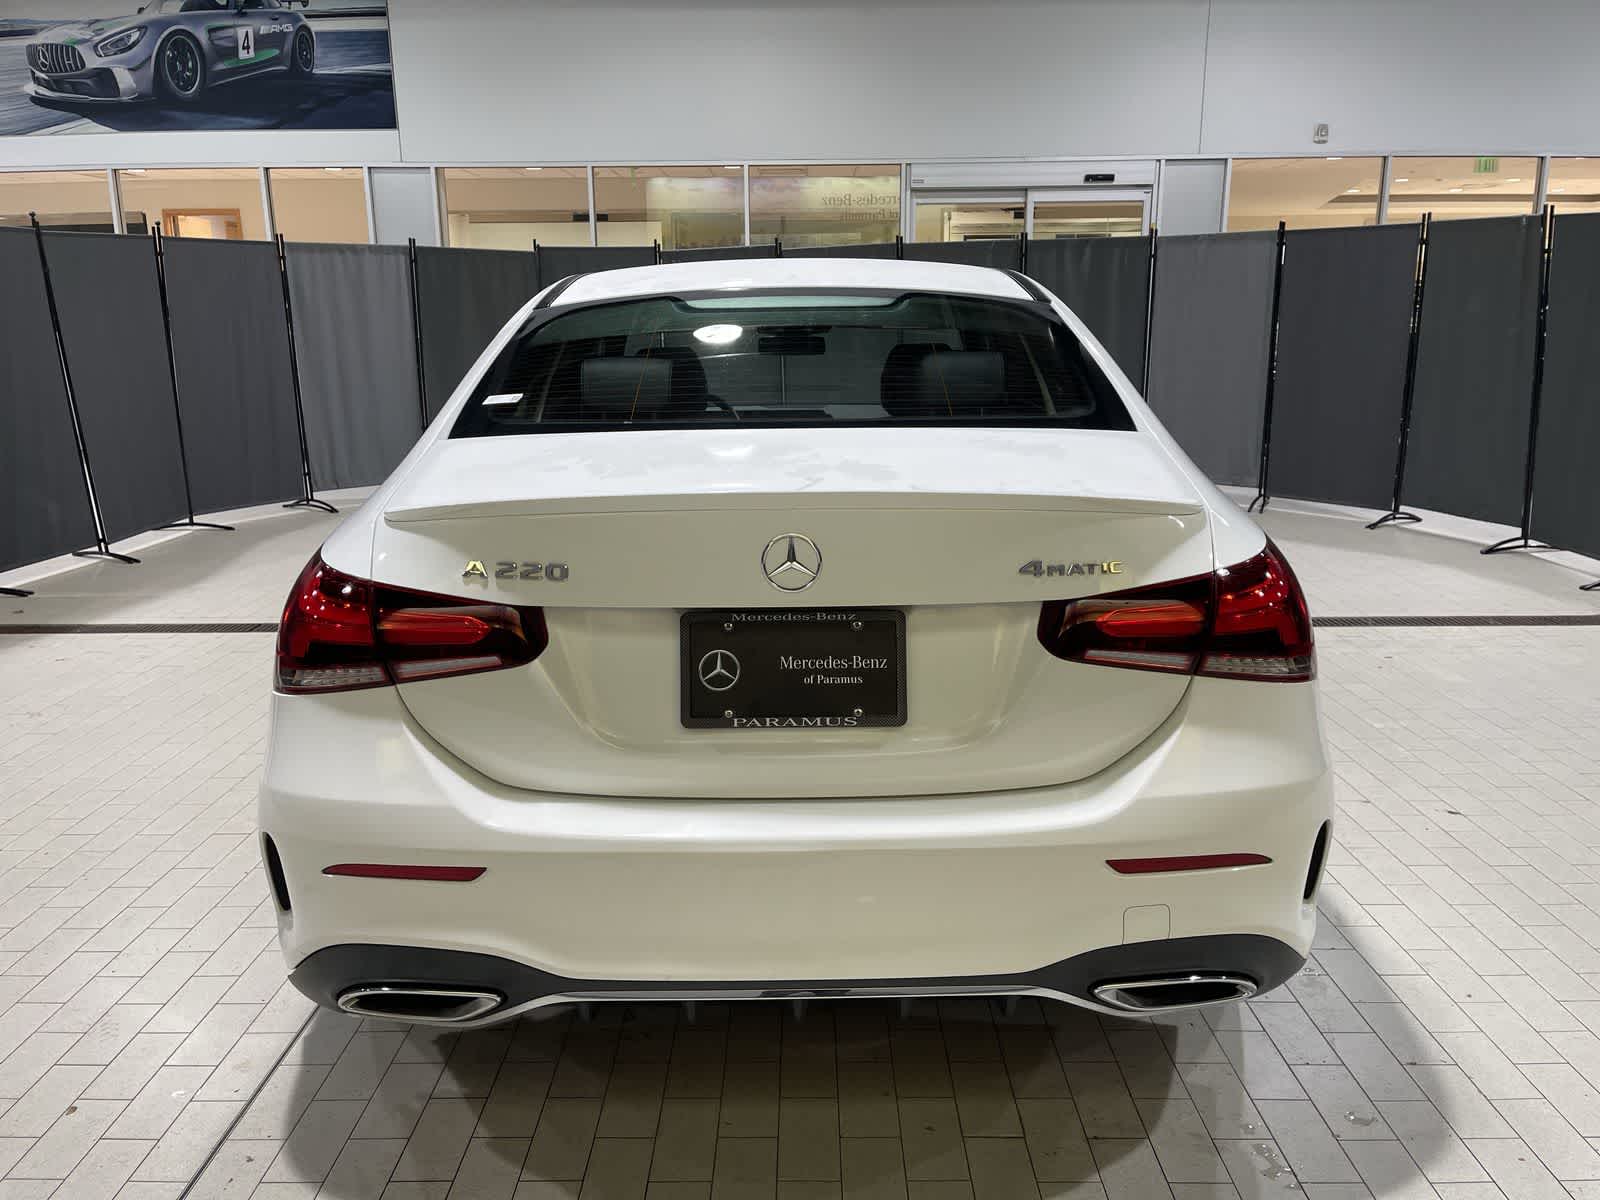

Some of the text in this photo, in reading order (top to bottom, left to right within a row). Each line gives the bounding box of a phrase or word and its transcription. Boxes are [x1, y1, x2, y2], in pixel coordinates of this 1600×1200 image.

[241, 30, 251, 55] 4
[462, 560, 569, 581] A 220
[1019, 560, 1122, 577] 4MATIC
[731, 612, 857, 622] Mercedes-Benz
[780, 655, 888, 670] Mercedes-Benz
[803, 674, 863, 685] of Paramus
[733, 716, 858, 728] PARAMUS
